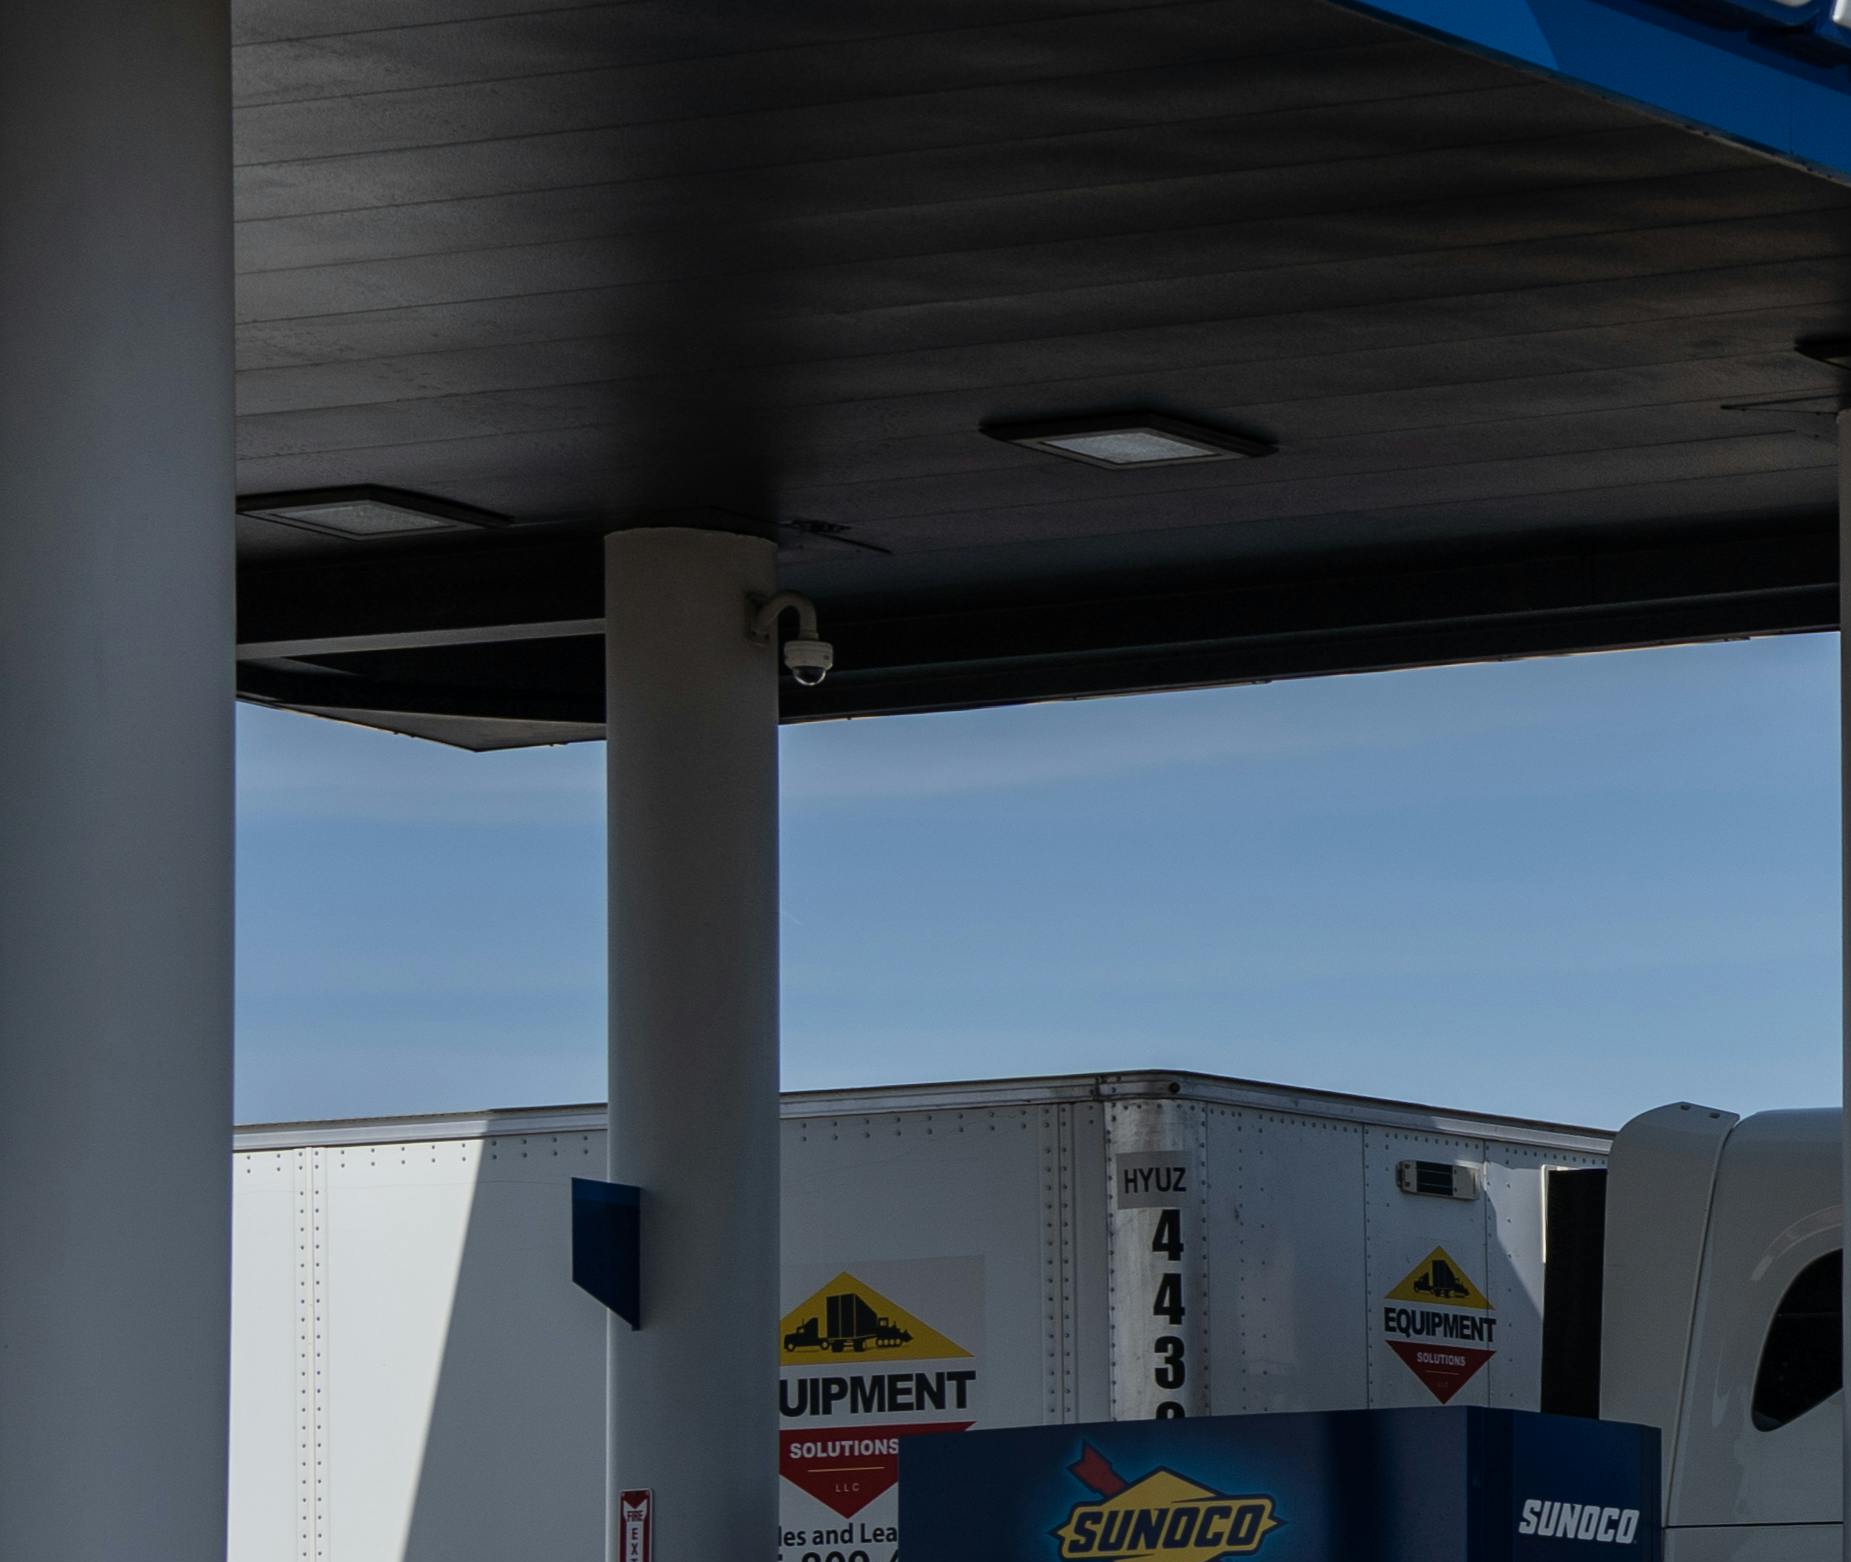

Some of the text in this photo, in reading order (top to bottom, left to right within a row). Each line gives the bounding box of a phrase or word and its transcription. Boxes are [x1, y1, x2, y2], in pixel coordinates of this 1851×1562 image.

[1123, 1166, 1187, 1194] HYUZ
[1384, 1306, 1497, 1342] EQUIPMENT
[1416, 1351, 1466, 1367] SOLUTIONS
[790, 1438, 899, 1459] SOLUTIONS
[835, 1482, 860, 1493] LLC
[1067, 1500, 1267, 1553] SUNOCO
[1518, 1498, 1640, 1545] SUNOCO
[812, 1523, 854, 1546] and
